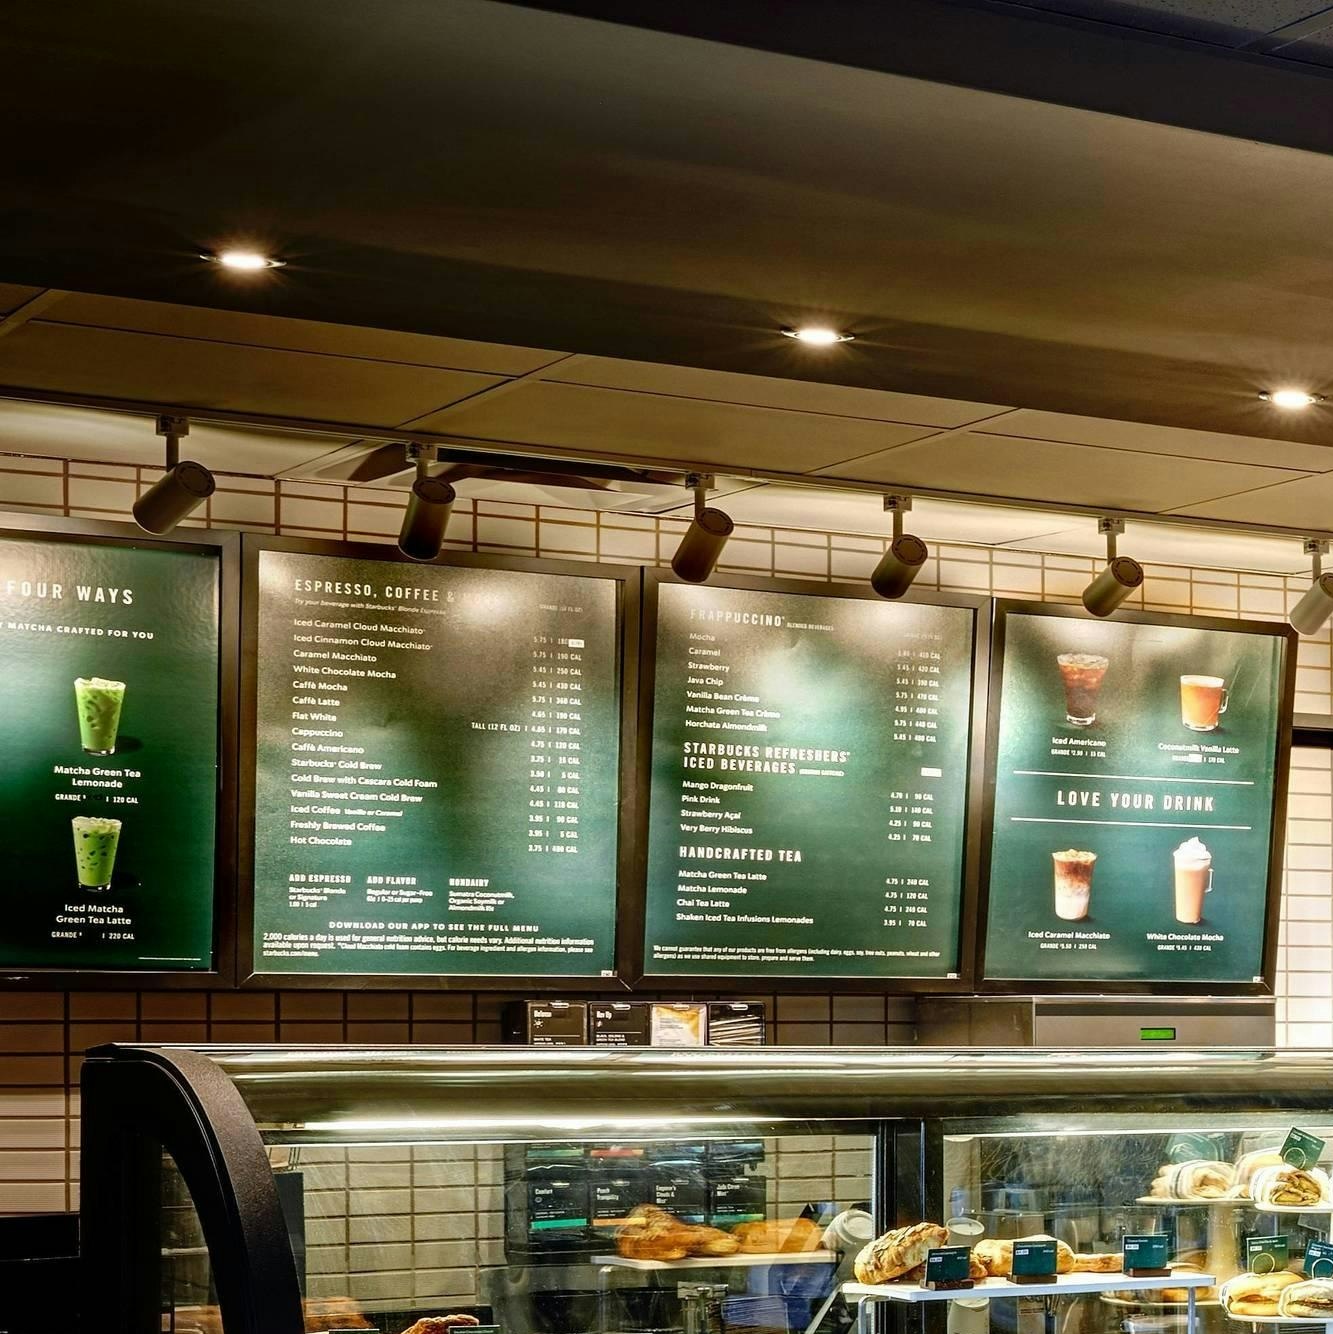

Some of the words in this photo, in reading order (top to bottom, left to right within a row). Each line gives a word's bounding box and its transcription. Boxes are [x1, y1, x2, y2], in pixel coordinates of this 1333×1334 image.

[6, 580, 62, 599] FOUR
[76, 585, 133, 604] WAYS
[295, 579, 377, 598] ESPRESSO,
[386, 586, 439, 601] COFFEE
[691, 608, 781, 627] FRAPPUCCINO
[8, 623, 52, 632] MATCHA
[57, 626, 103, 635] CRAFTED
[294, 619, 312, 627] Iced
[315, 620, 351, 629] Caramel
[353, 622, 377, 631] Cloud
[294, 634, 312, 642] Iced
[315, 636, 358, 645] Cinnamon
[361, 638, 385, 647] Cloud
[293, 650, 330, 658] Caramel
[332, 652, 377, 662] Macchiato
[688, 662, 729, 672] Strawberry
[322, 667, 365, 677] Chocolate
[367, 670, 396, 678] Mocha
[688, 676, 704, 684] Java
[706, 678, 723, 686] Chip
[318, 683, 348, 691] Mocha
[318, 698, 340, 706] Latte
[472, 722, 485, 730] TALL
[292, 728, 343, 738] Cappuccino
[684, 742, 759, 758] STARBUCKS
[684, 757, 714, 769] ICED
[721, 759, 795, 774] BEVERAGES
[54, 766, 90, 776] Matcha
[93, 768, 122, 777] Green
[125, 769, 141, 777] Tea
[72, 779, 122, 788] Lemonade
[683, 781, 708, 789] Mango
[1057, 790, 1100, 806] LOVE
[1110, 793, 1153, 809] YOUR
[1164, 795, 1214, 811] DRINK
[681, 824, 698, 832] Very
[699, 825, 720, 833] Berry
[721, 826, 752, 834] Hibiscus
[291, 836, 307, 844] Hot
[308, 837, 352, 846] Chocolate
[680, 846, 772, 861] HANDCRAFTED
[779, 850, 801, 862] TEA
[733, 872, 746, 880] Tea
[88, 905, 123, 913] Matcha
[56, 916, 85, 924] Green
[88, 916, 104, 924] Tea
[107, 917, 131, 925] Latte
[388, 922, 408, 930] OUR
[1045, 931, 1073, 939] Caramel
[1075, 932, 1110, 940] Macchiato
